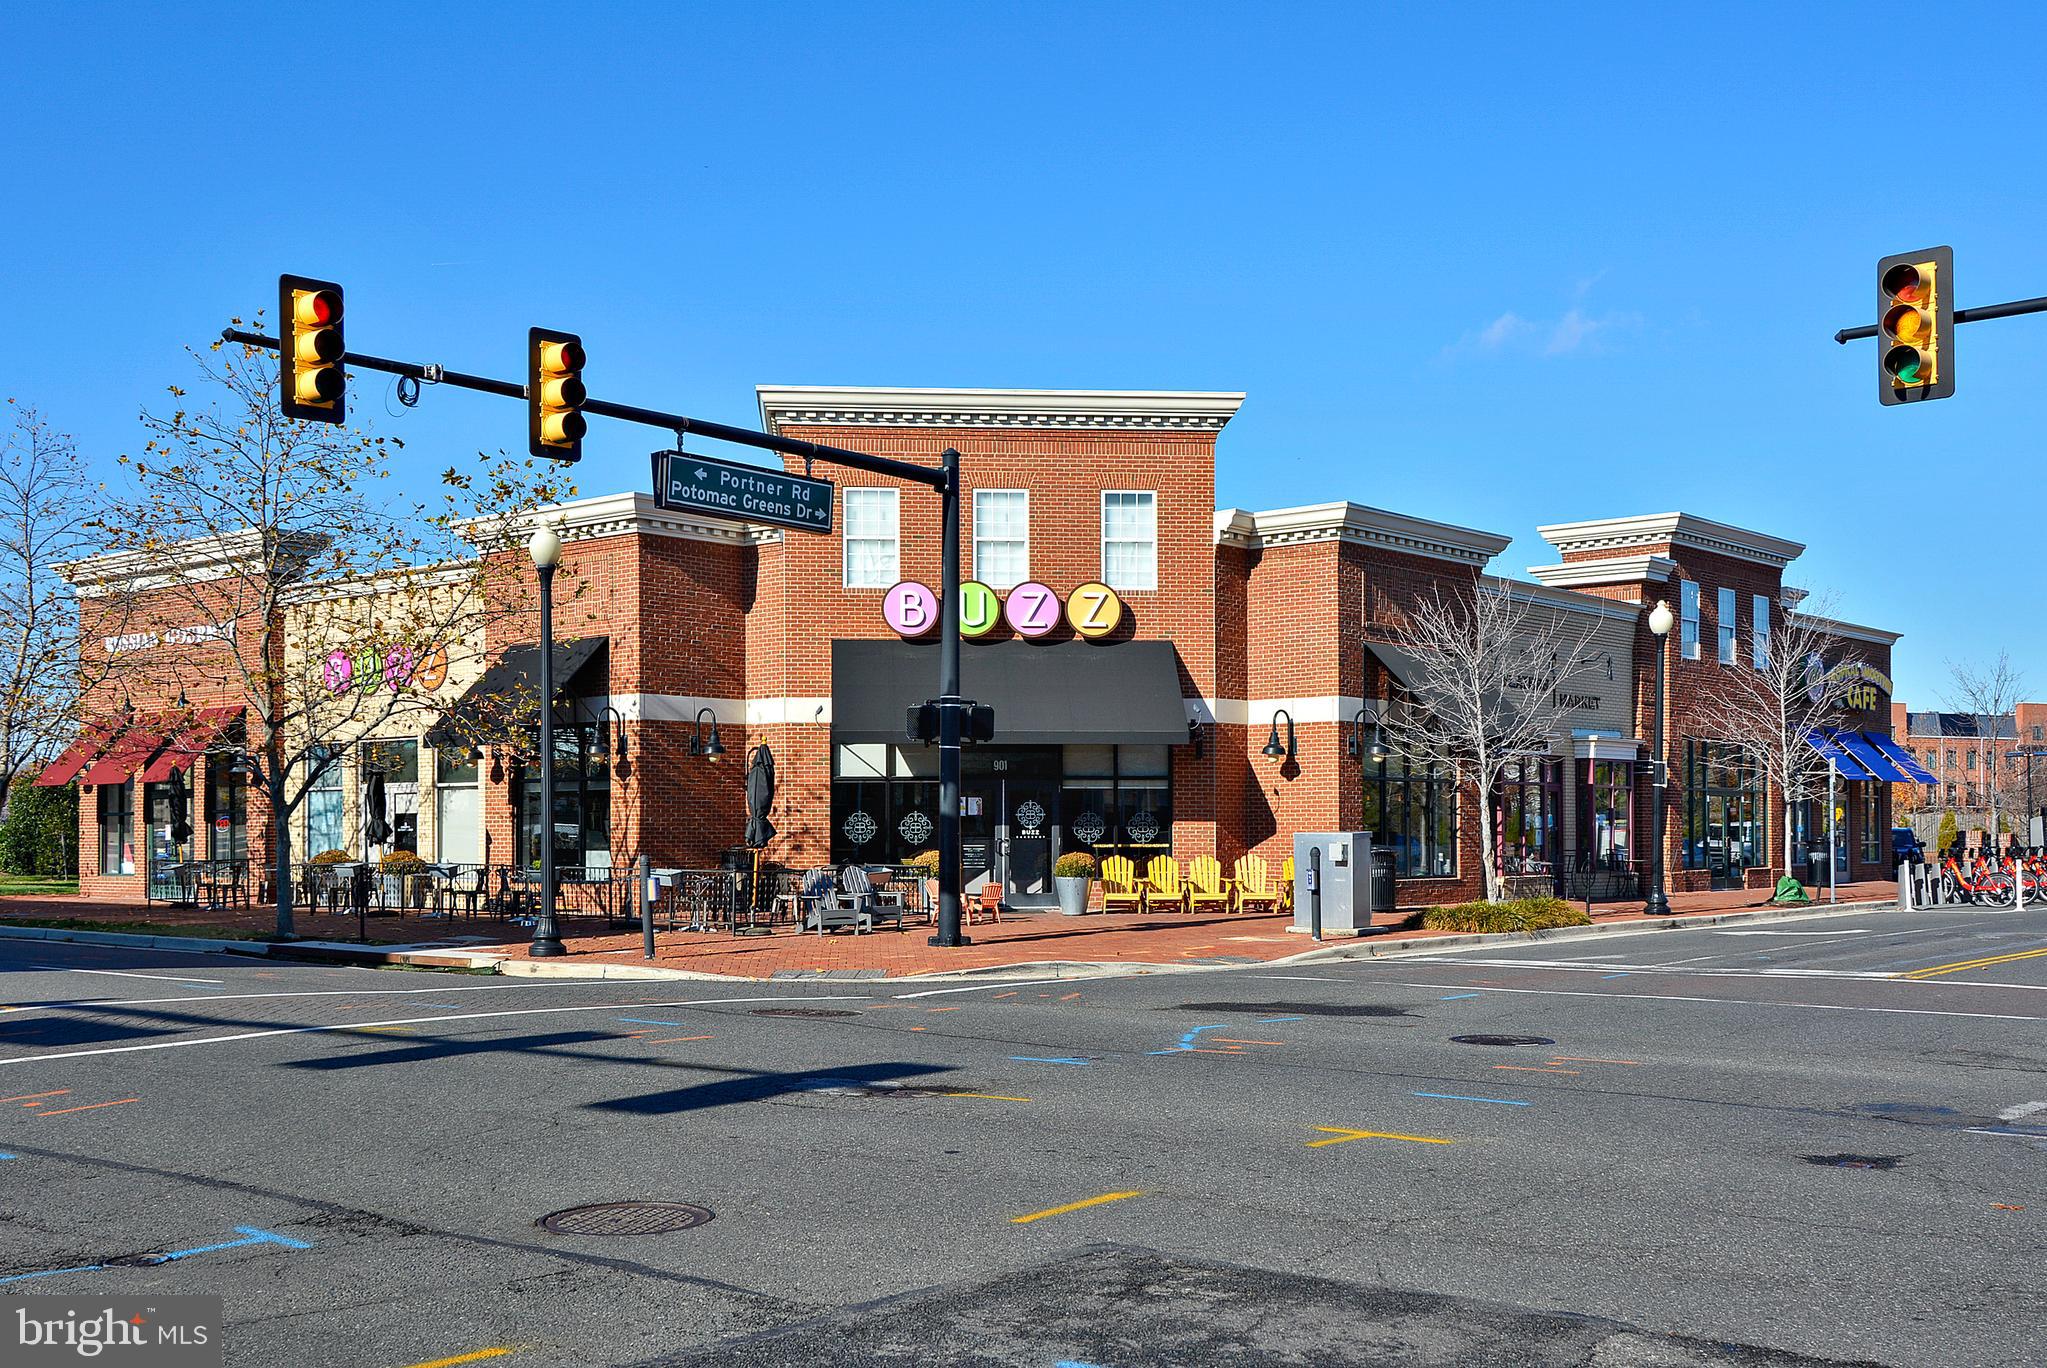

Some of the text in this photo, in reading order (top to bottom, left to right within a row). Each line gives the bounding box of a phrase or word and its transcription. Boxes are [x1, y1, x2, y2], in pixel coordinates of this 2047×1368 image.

[671, 481, 813, 519] Potomac Greens Dr
[720, 470, 810, 501] Portner Rd
[900, 590, 1109, 628] BUZZ
[1847, 685, 1877, 711] CAFE
[993, 760, 1008, 771] 901
